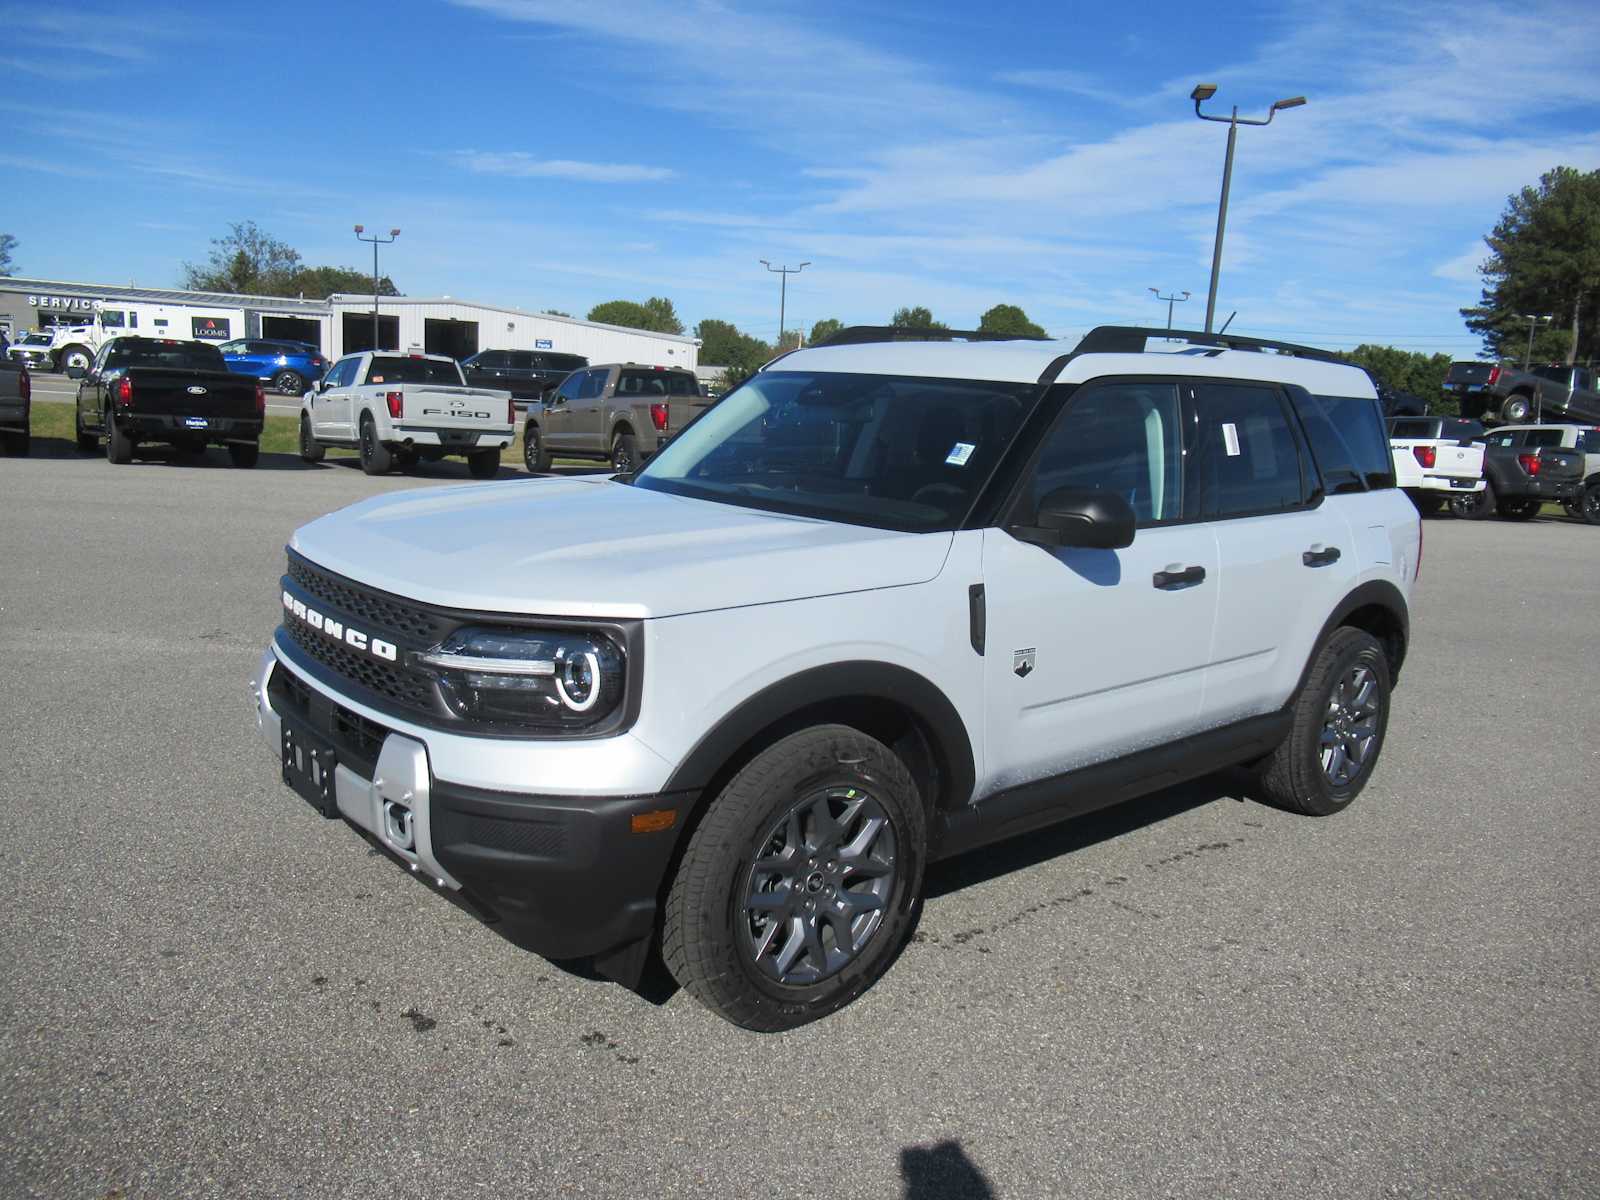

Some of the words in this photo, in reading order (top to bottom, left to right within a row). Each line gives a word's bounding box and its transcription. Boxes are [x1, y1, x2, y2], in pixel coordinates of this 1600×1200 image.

[194, 327, 228, 337] LOOMIS
[423, 408, 490, 419] F-150
[282, 591, 397, 662] BRONCO
